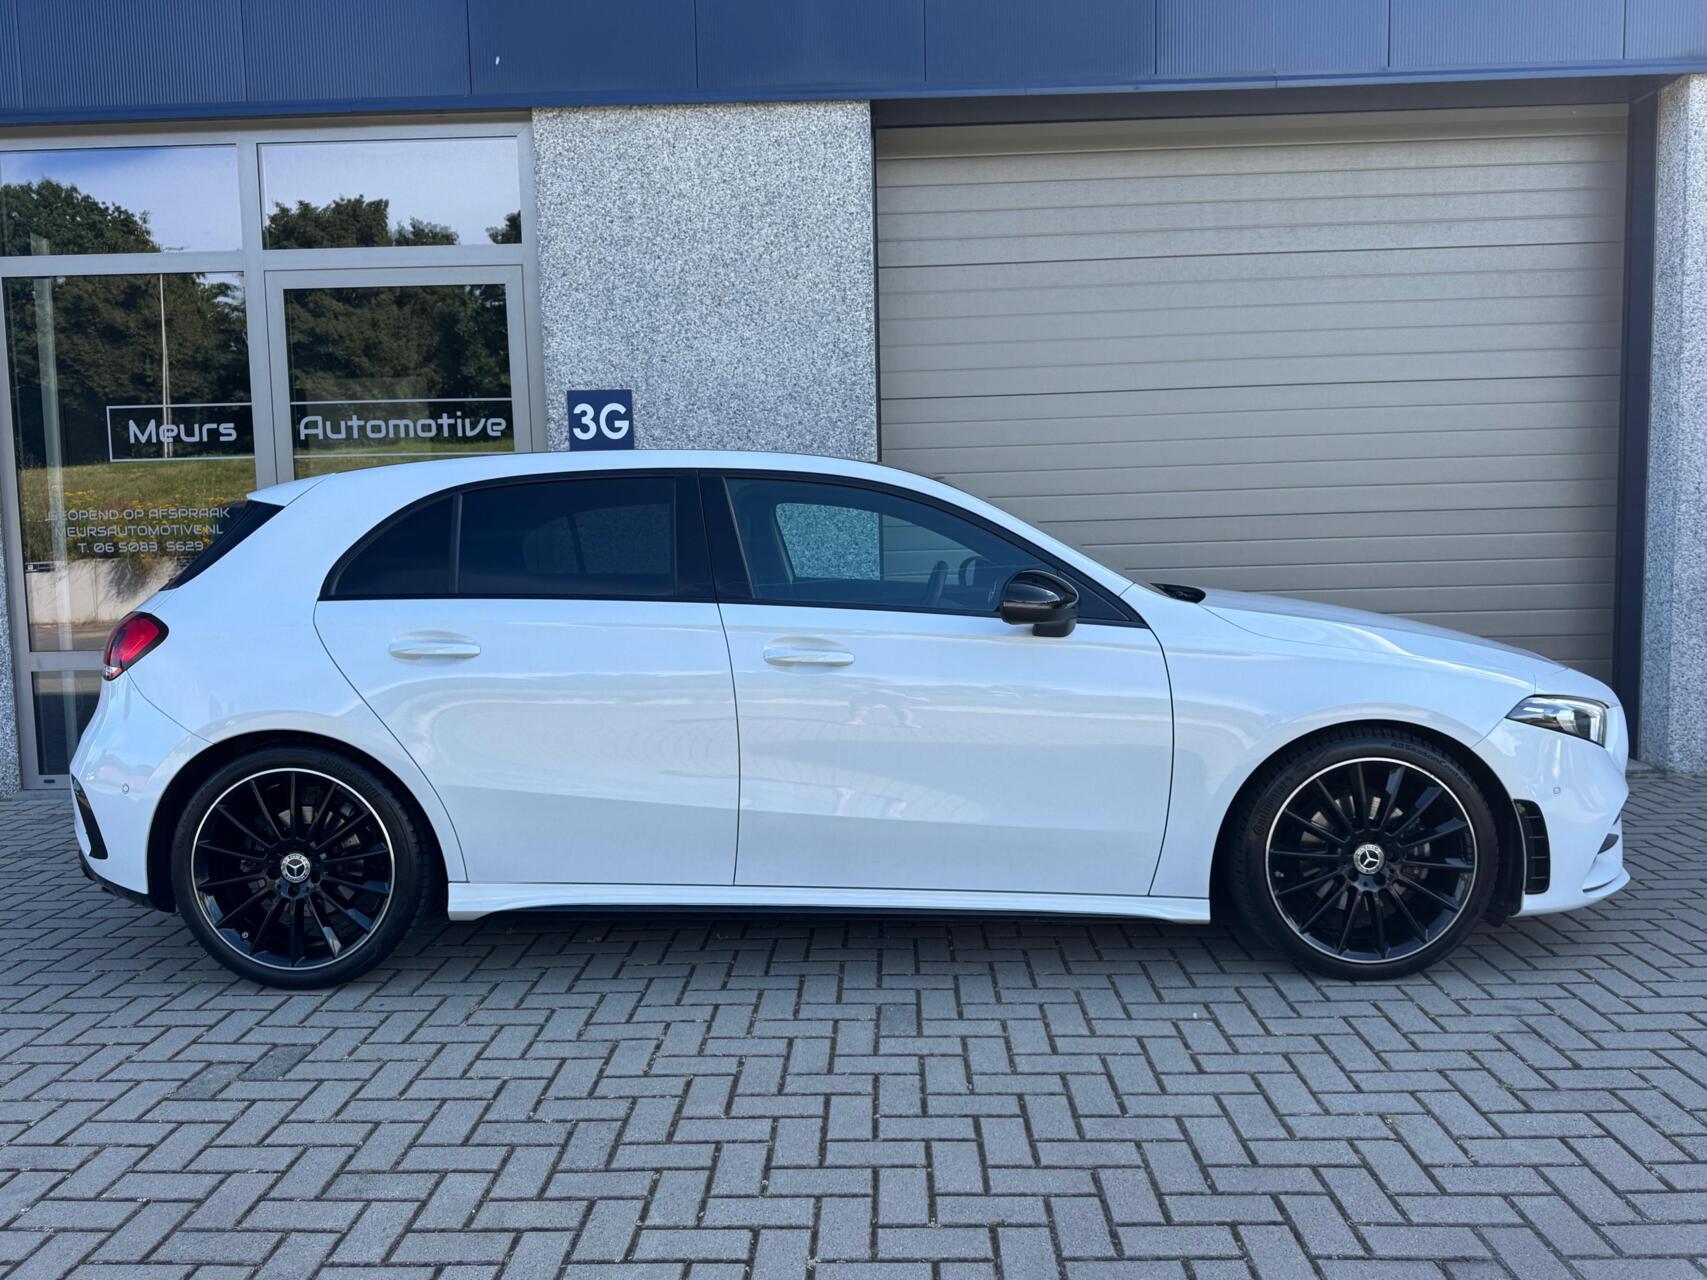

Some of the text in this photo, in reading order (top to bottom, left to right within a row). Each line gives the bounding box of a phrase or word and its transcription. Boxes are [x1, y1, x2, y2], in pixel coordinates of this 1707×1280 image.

[128, 411, 507, 444] Meurs Automotive
[572, 402, 630, 440] 3G
[48, 507, 230, 520] GEOPEND OP AFSPRAAK
[77, 541, 204, 553] T. 06 5083 5629
